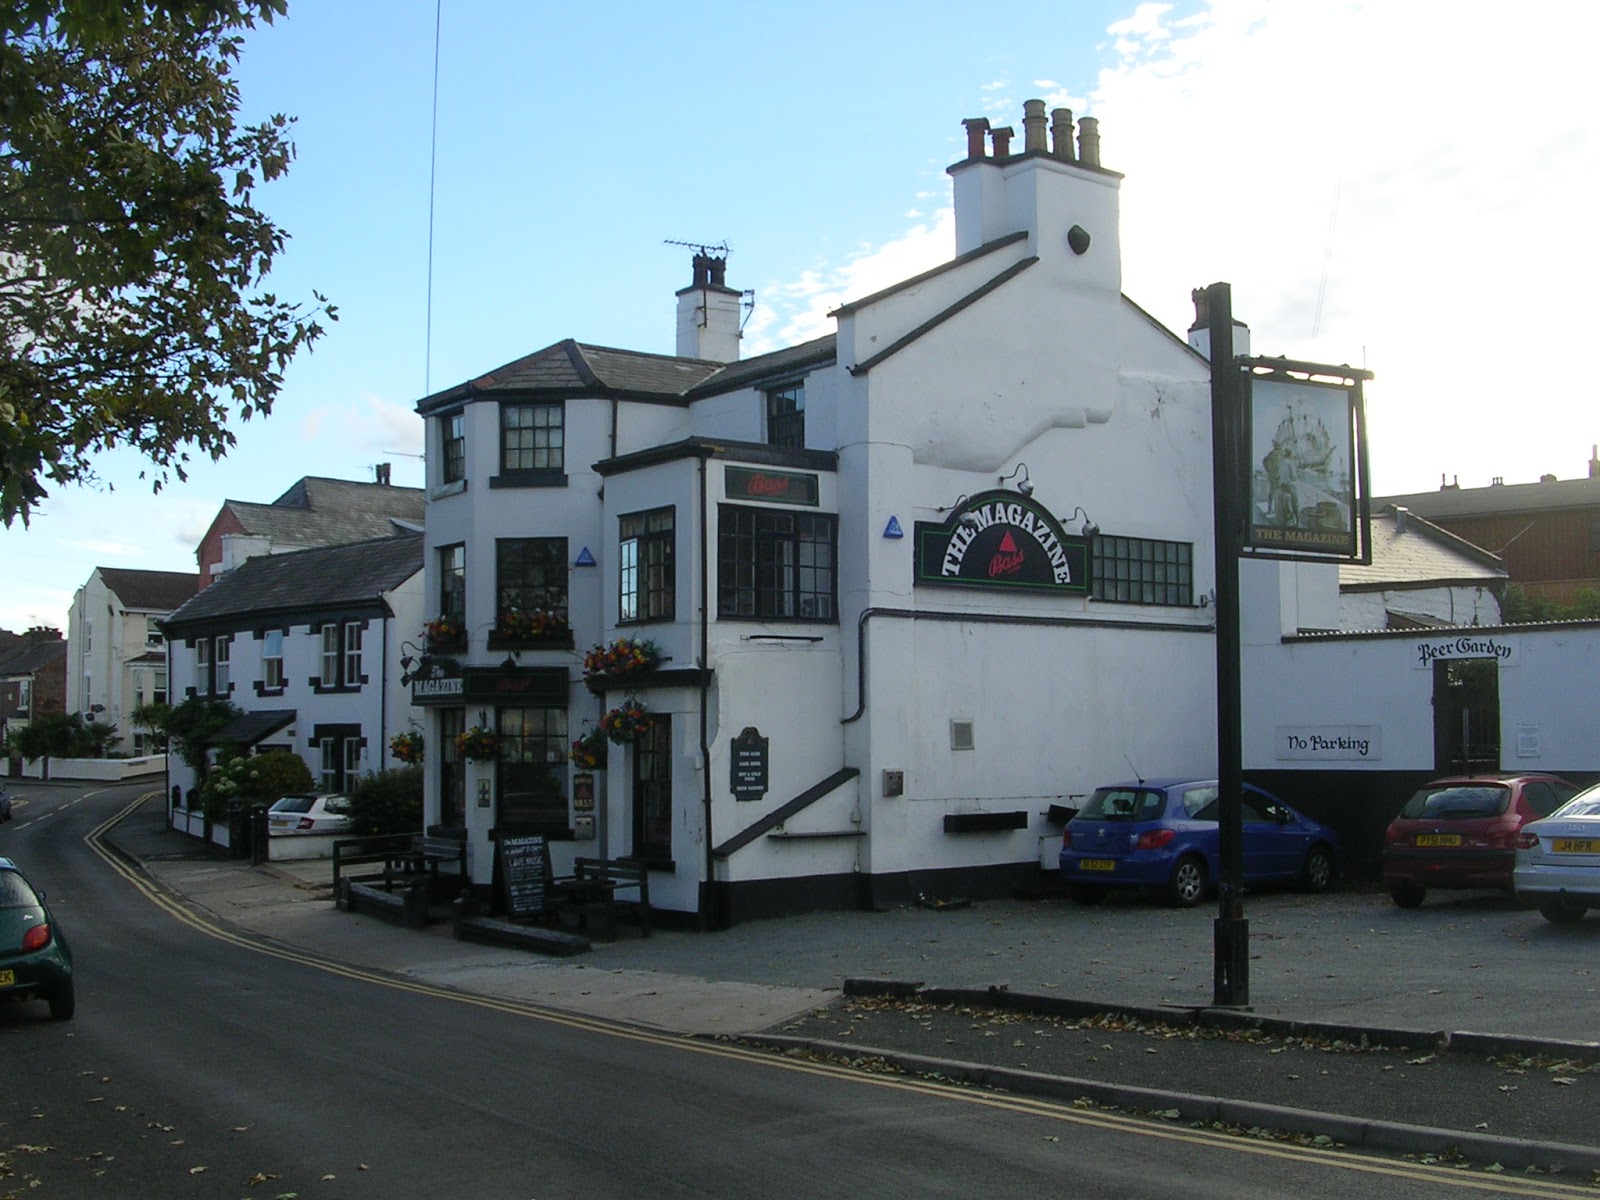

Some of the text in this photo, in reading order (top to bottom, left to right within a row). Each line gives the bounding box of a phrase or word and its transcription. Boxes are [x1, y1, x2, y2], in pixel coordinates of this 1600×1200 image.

[941, 502, 1071, 584] THE MAGAZINE
[1255, 528, 1349, 545] THE MAGAZINE
[988, 550, 1024, 577] Bass
[1455, 638, 1512, 658] Garden
[414, 678, 463, 696] MAGAZINE
[1287, 735, 1370, 756] No Parking
